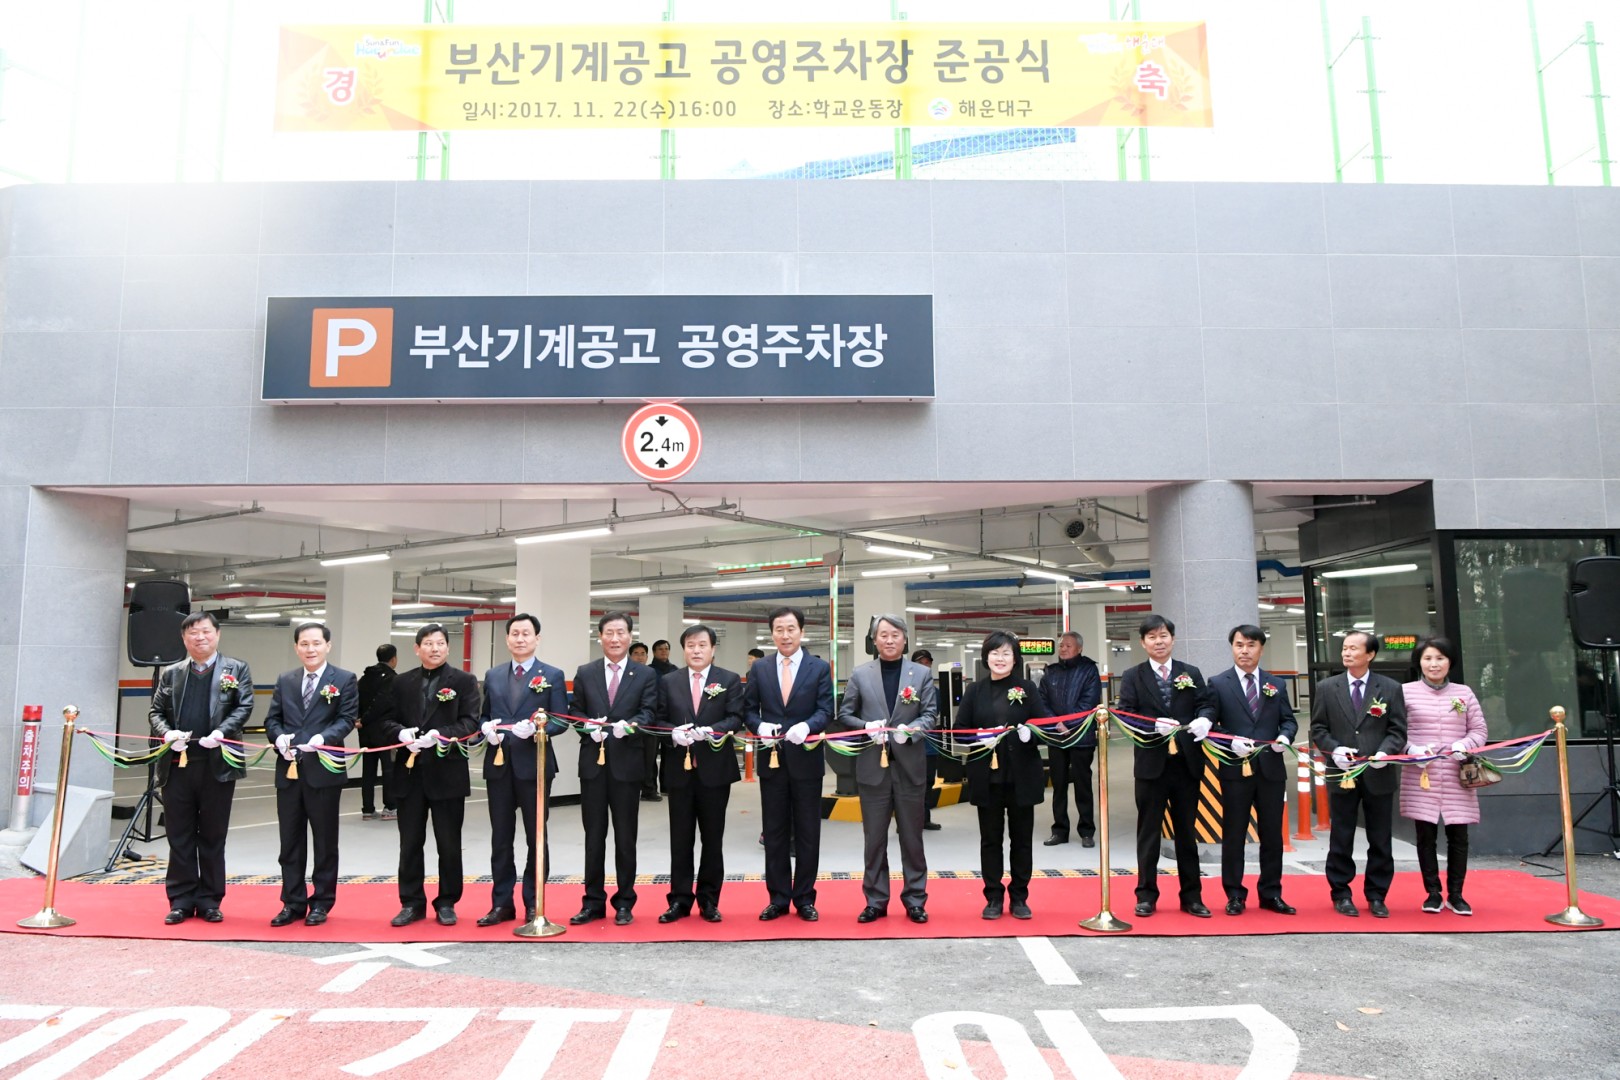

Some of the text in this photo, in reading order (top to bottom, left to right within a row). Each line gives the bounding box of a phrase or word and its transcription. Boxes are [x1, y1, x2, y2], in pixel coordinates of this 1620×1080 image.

[444, 40, 691, 86] 부산기계공고
[710, 38, 914, 86] 공영주차장
[933, 38, 1050, 84] 준공식
[326, 70, 354, 102] 경
[1137, 64, 1167, 97] 축
[573, 101, 604, 118] 11.
[768, 98, 904, 120] 장소:학교운동장
[958, 99, 1033, 119] 해운대구
[325, 318, 378, 377] P
[409, 323, 888, 369] 부산기계공고 공영주차장
[640, 431, 684, 452] 2.4m
[18, 730, 34, 789] 출차주의
